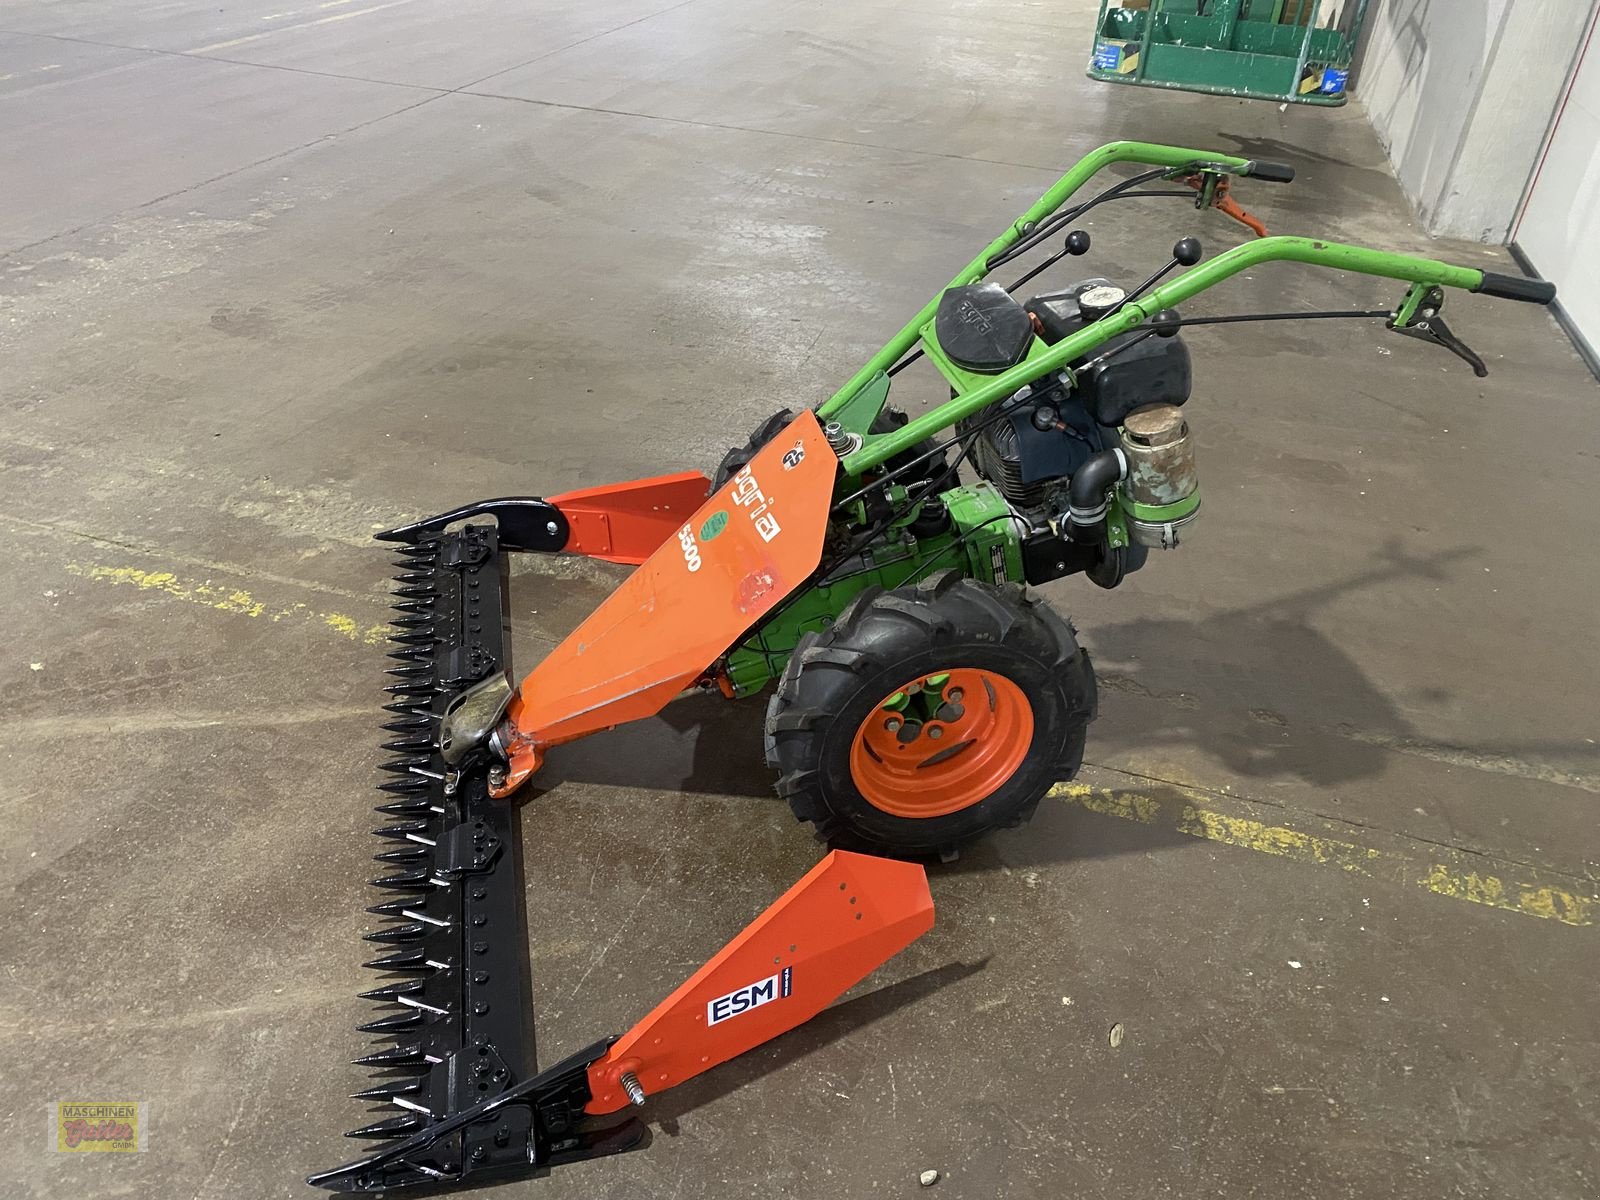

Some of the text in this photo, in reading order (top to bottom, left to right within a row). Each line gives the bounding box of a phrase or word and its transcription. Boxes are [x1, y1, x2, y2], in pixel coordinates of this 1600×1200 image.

[731, 464, 782, 544] agria
[677, 523, 702, 572] 5500
[713, 979, 773, 1022] ESM
